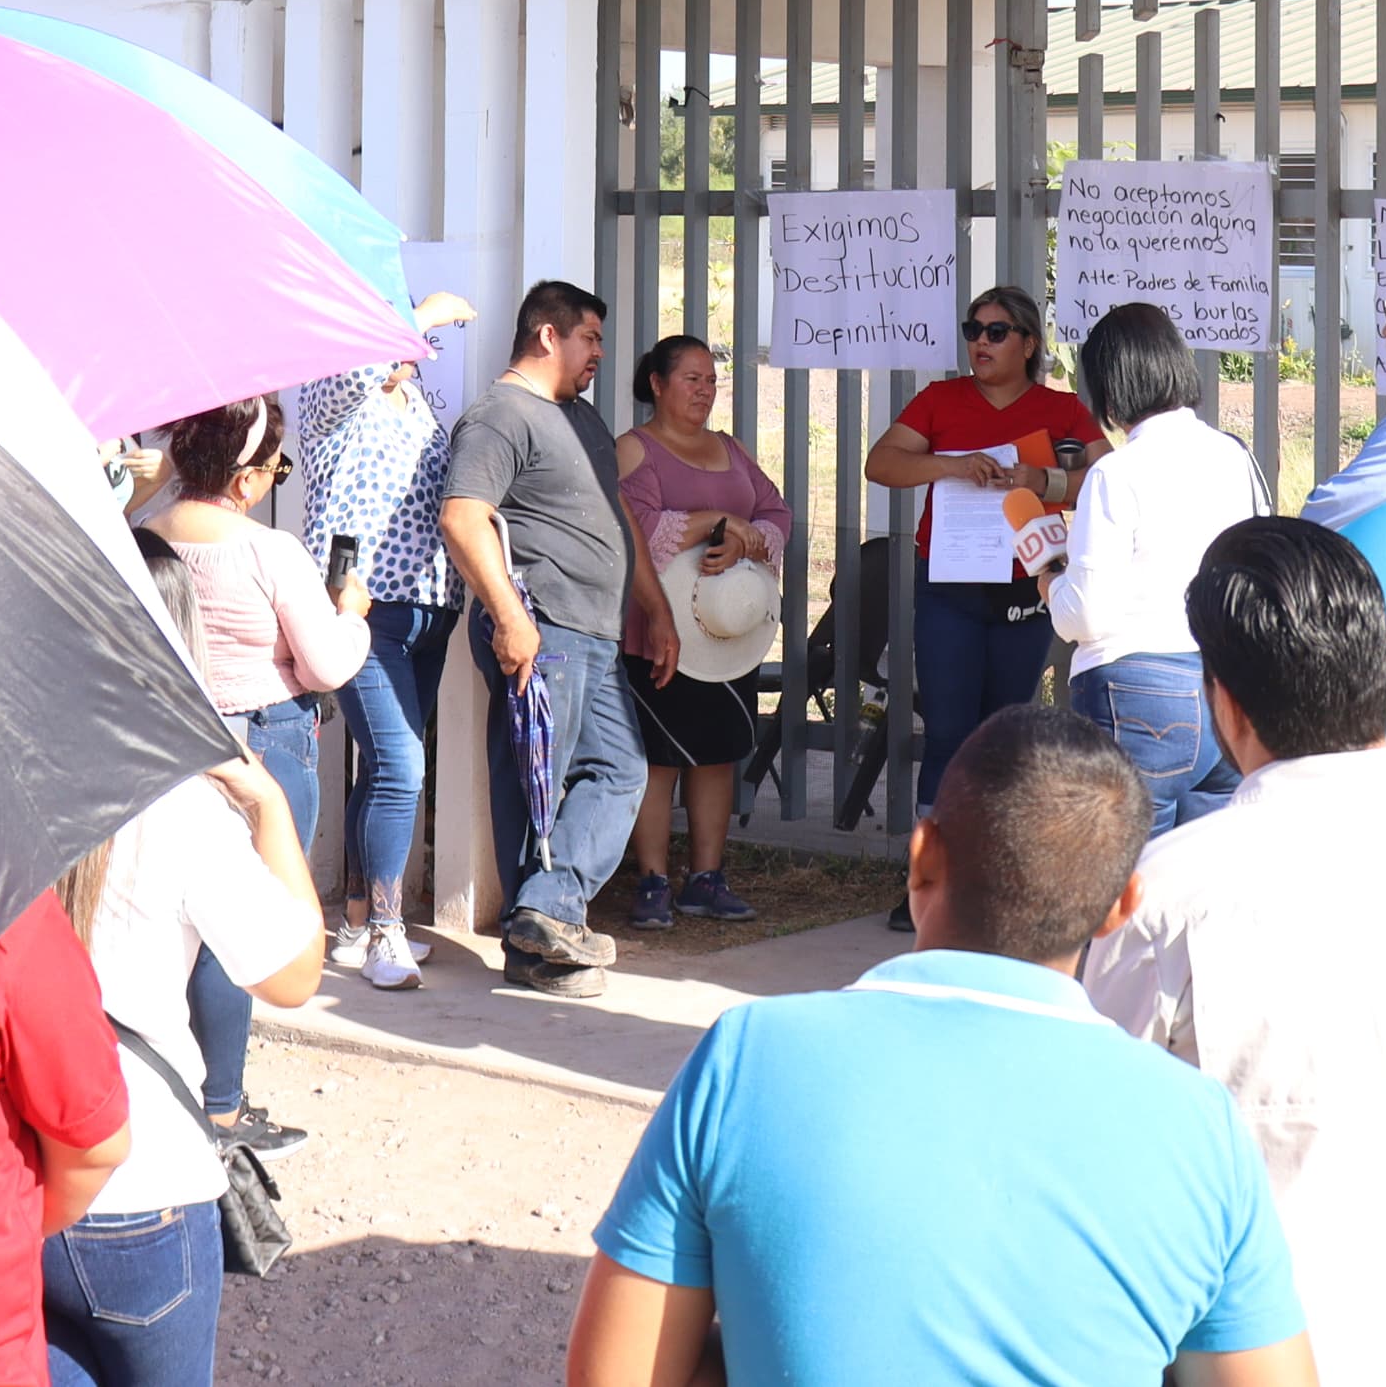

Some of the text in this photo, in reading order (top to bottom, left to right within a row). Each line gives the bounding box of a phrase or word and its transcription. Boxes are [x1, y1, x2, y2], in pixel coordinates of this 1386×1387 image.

[1069, 178, 1100, 199] No
[782, 212, 920, 260] Exigimos
[1067, 205, 1256, 242] negociación alguna
[1069, 233, 1229, 262] no la queremos
[1123, 269, 1177, 291] Padres
[1184, 270, 1205, 291] de
[1207, 270, 1269, 296] Familia
[1194, 302, 1259, 323] burlas
[793, 302, 936, 356] Definitiva.
[1179, 322, 1261, 346] ansados
